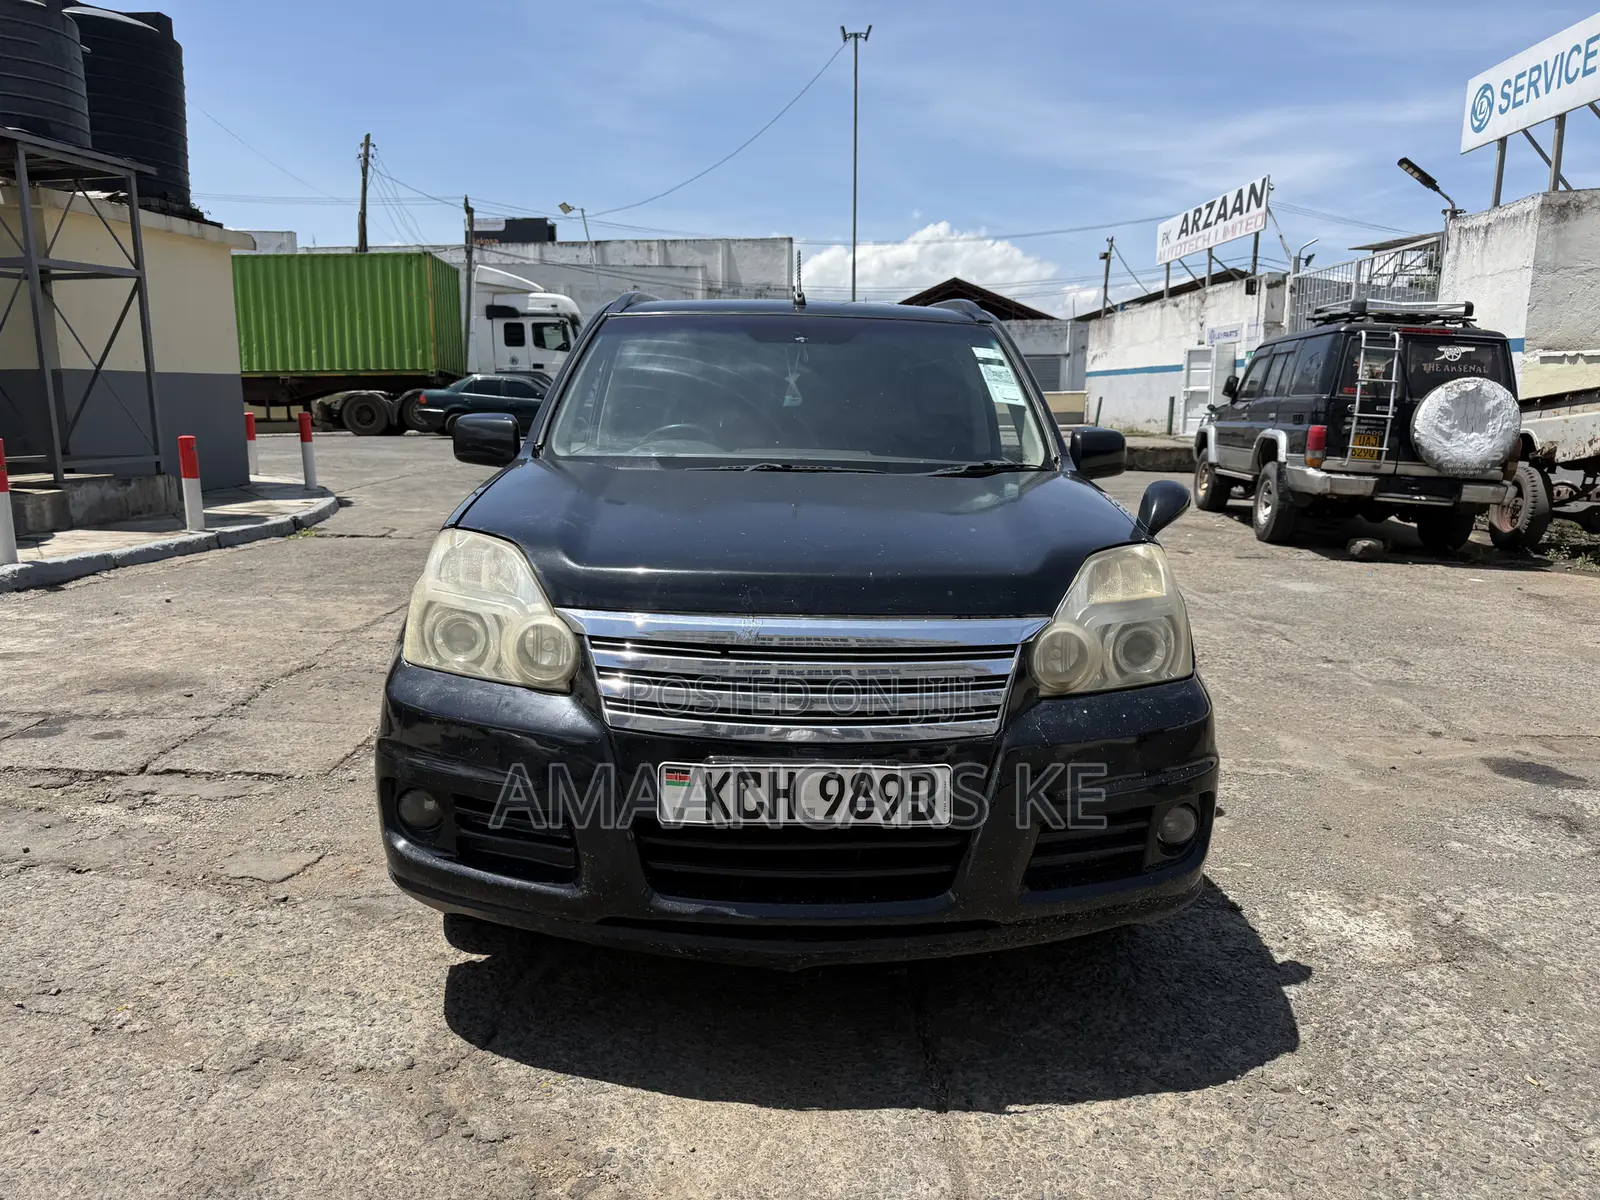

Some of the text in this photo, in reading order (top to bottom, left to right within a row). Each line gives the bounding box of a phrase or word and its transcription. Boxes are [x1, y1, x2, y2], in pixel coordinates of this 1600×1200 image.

[1498, 33, 1600, 115] SERVICE
[1177, 177, 1267, 240] ARZAAN
[1422, 363, 1489, 374] THE ARSENAL
[705, 771, 797, 820] KCH
